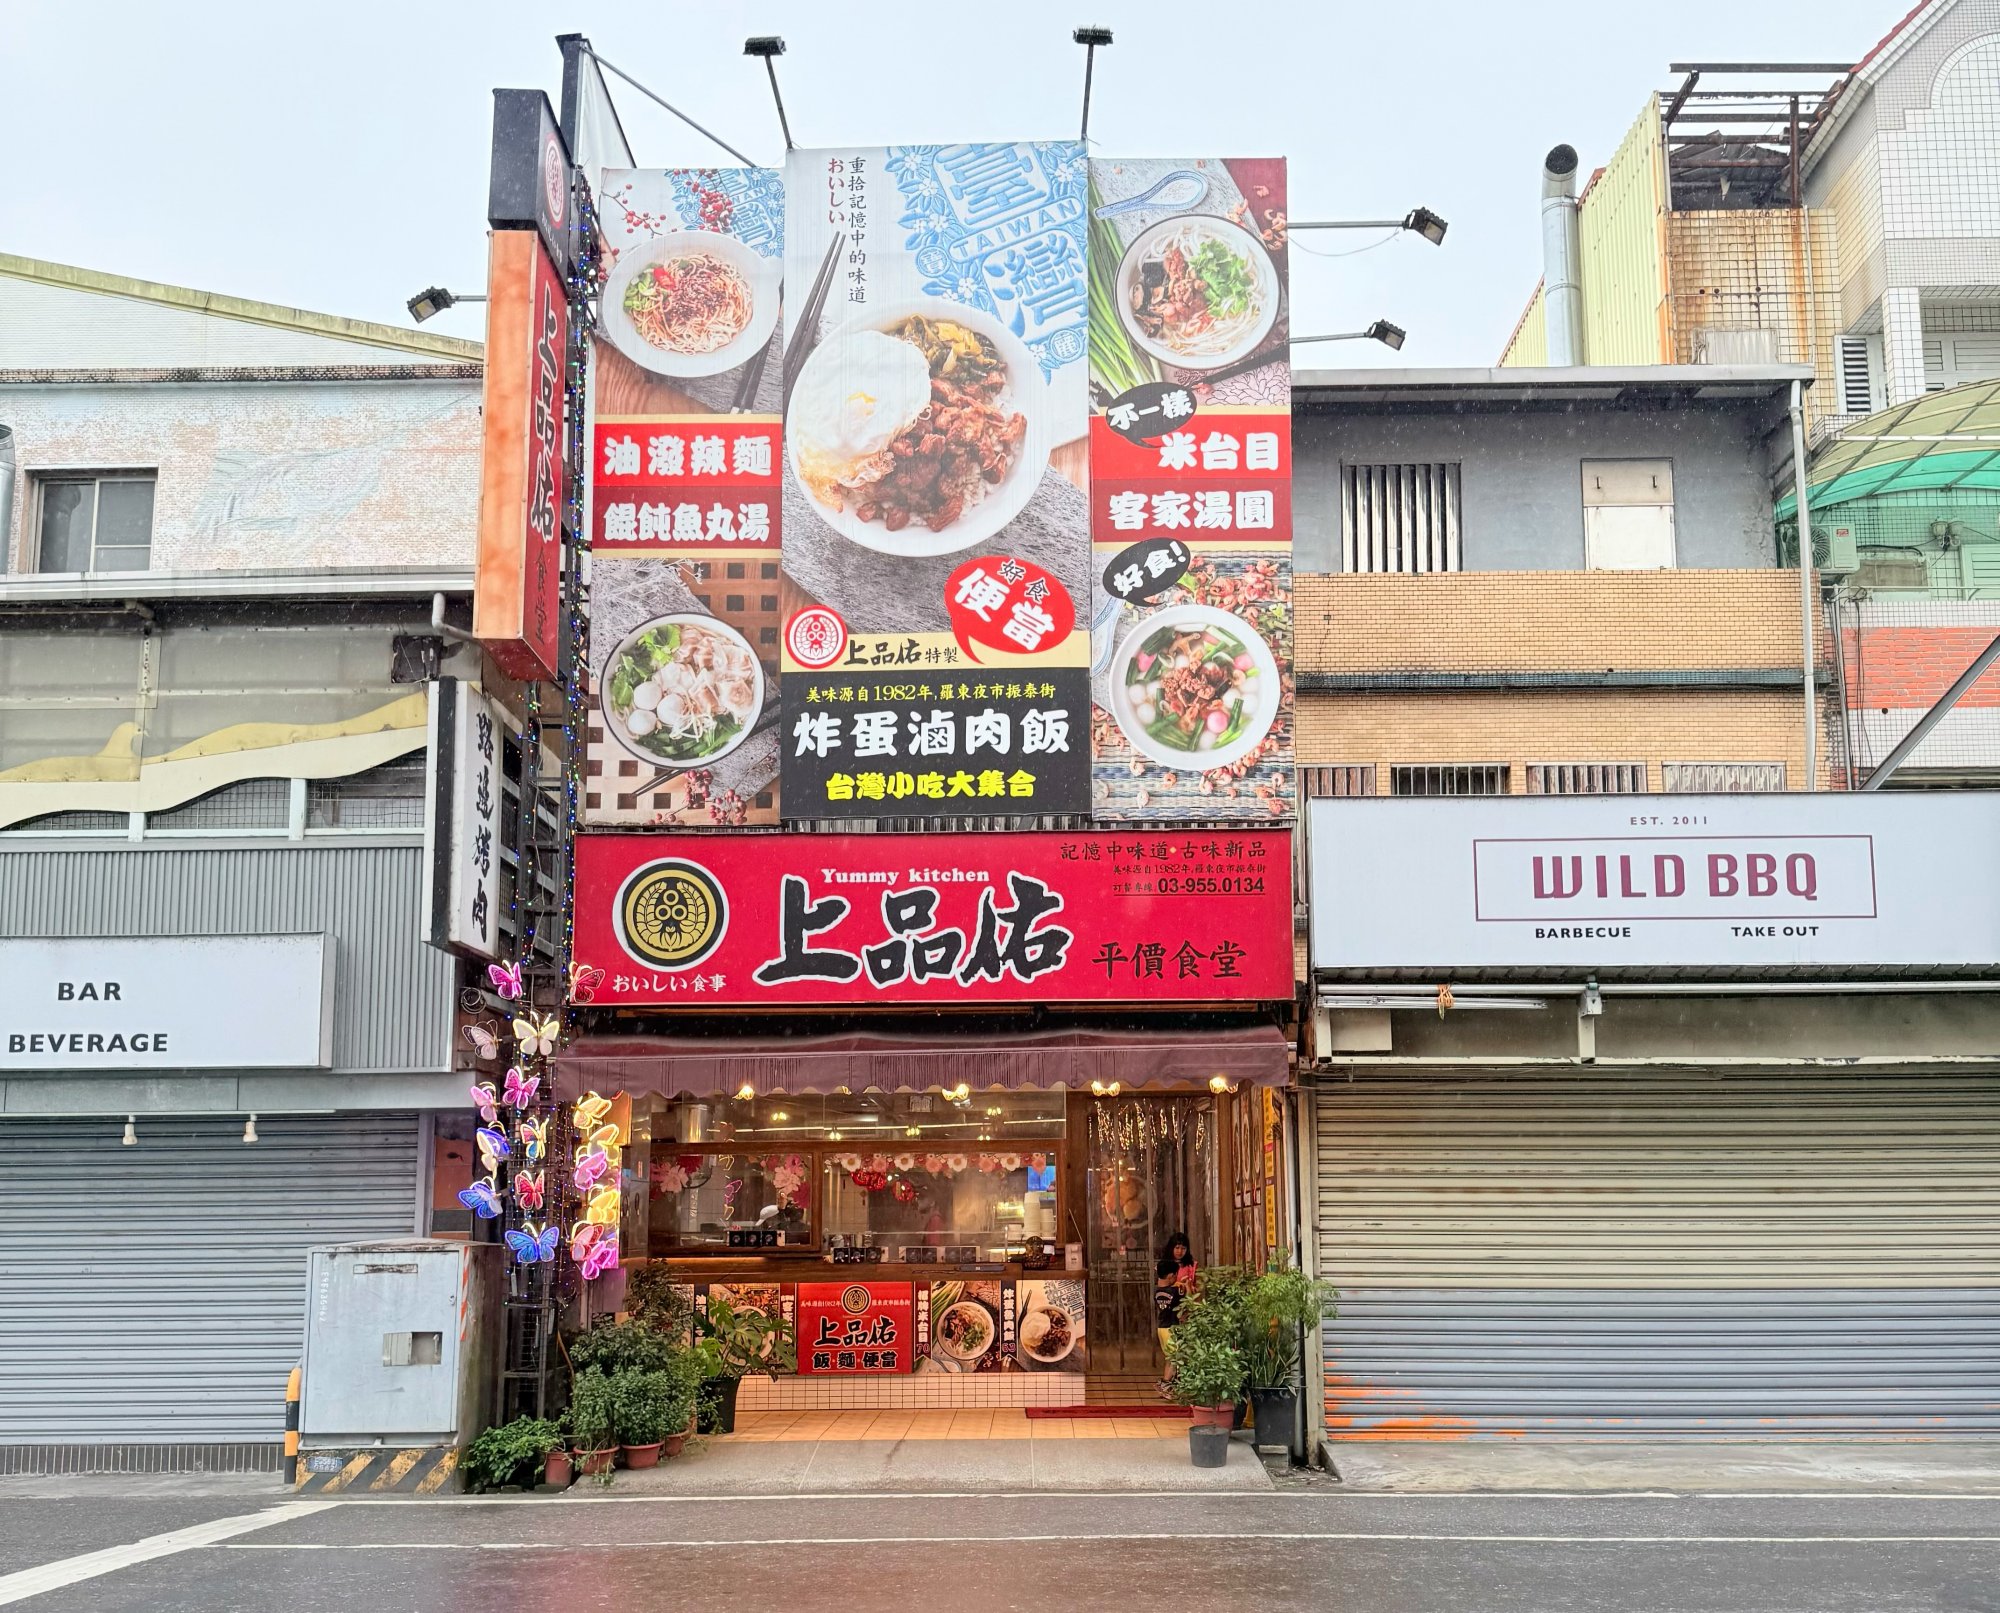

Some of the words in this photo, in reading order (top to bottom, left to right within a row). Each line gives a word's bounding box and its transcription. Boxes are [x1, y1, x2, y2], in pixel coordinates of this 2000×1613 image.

[828, 157, 845, 224] おいしい
[847, 157, 867, 304] 重拾記憶中的味道
[953, 199, 1077, 257] TAIWAN
[531, 280, 557, 544] 上品佑
[1109, 388, 1194, 431] 不一樣
[603, 435, 772, 477] 油潑辣麵
[1158, 431, 1280, 471] 米台目
[603, 502, 770, 543] 餛飩魚丸湯
[1108, 490, 1275, 531] 客家湯圓
[997, 559, 1051, 604] 好食
[955, 568, 1055, 651] 便當
[843, 638, 921, 668] 上品佑
[925, 646, 959, 664] 特製
[794, 708, 1071, 758] 炸蛋滷肉飯
[825, 769, 1037, 801] 台灣小吃大集合
[1630, 816, 1664, 825] EST.
[1672, 815, 1709, 825] 2011
[822, 867, 900, 886] Yummy
[908, 867, 991, 883] kitchen
[1158, 877, 1265, 893] 03-955.0134
[1533, 854, 1686, 899] WILD
[1708, 853, 1818, 901] BBQ
[750, 868, 1074, 989] 上品佑
[1535, 927, 1631, 939] BARBECUE
[1731, 926, 1776, 938] TAKE
[1782, 926, 1818, 938] OUT
[1092, 940, 1247, 980] 平價食堂
[57, 982, 121, 1001] BAR
[612, 973, 727, 994] おいしい食事
[9, 1033, 168, 1053] BEVERAGE
[813, 1315, 897, 1347] 上品佑
